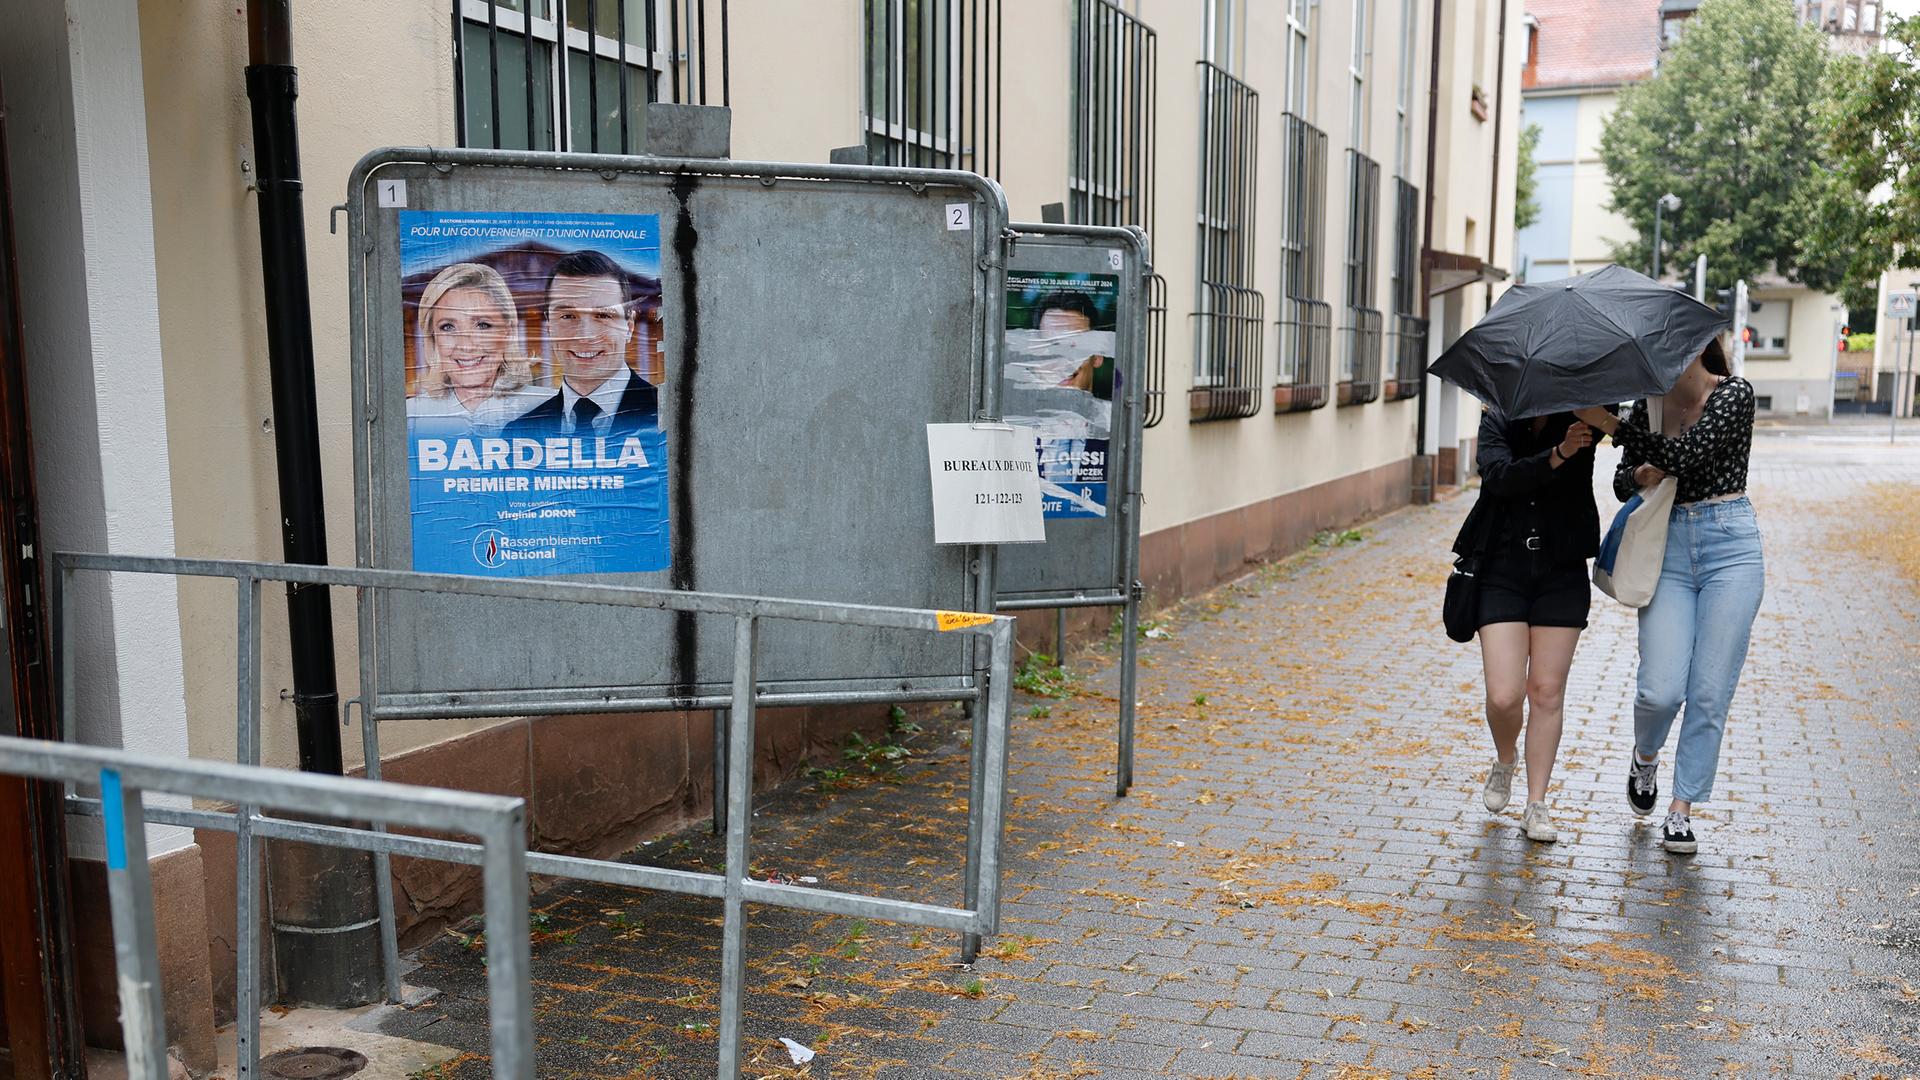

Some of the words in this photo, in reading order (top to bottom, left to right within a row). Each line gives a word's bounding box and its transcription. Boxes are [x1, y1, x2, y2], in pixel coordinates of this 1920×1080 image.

[388, 184, 396, 202] 1
[952, 208, 963, 225] 2
[411, 226, 441, 236] POUR
[442, 227, 459, 236] UN
[460, 227, 545, 237] GOUVERNEMENT
[546, 228, 589, 238] D'UNION
[591, 229, 647, 240] NATIONALE
[1112, 254, 1119, 266] 6
[1007, 276, 1040, 285] ÉGISLATIVES
[418, 438, 649, 471] BARDELLA
[943, 460, 1002, 472] BUREAUX
[1003, 460, 1014, 472] DE
[1015, 460, 1034, 473] VOTE
[444, 477, 529, 493] PREMIER
[534, 475, 625, 492] MINISTRE
[975, 493, 1023, 504] 121-122-123
[497, 510, 537, 520] Virginie
[539, 509, 576, 518] JORON
[501, 535, 602, 547] Rassemblement
[501, 548, 556, 561] National
